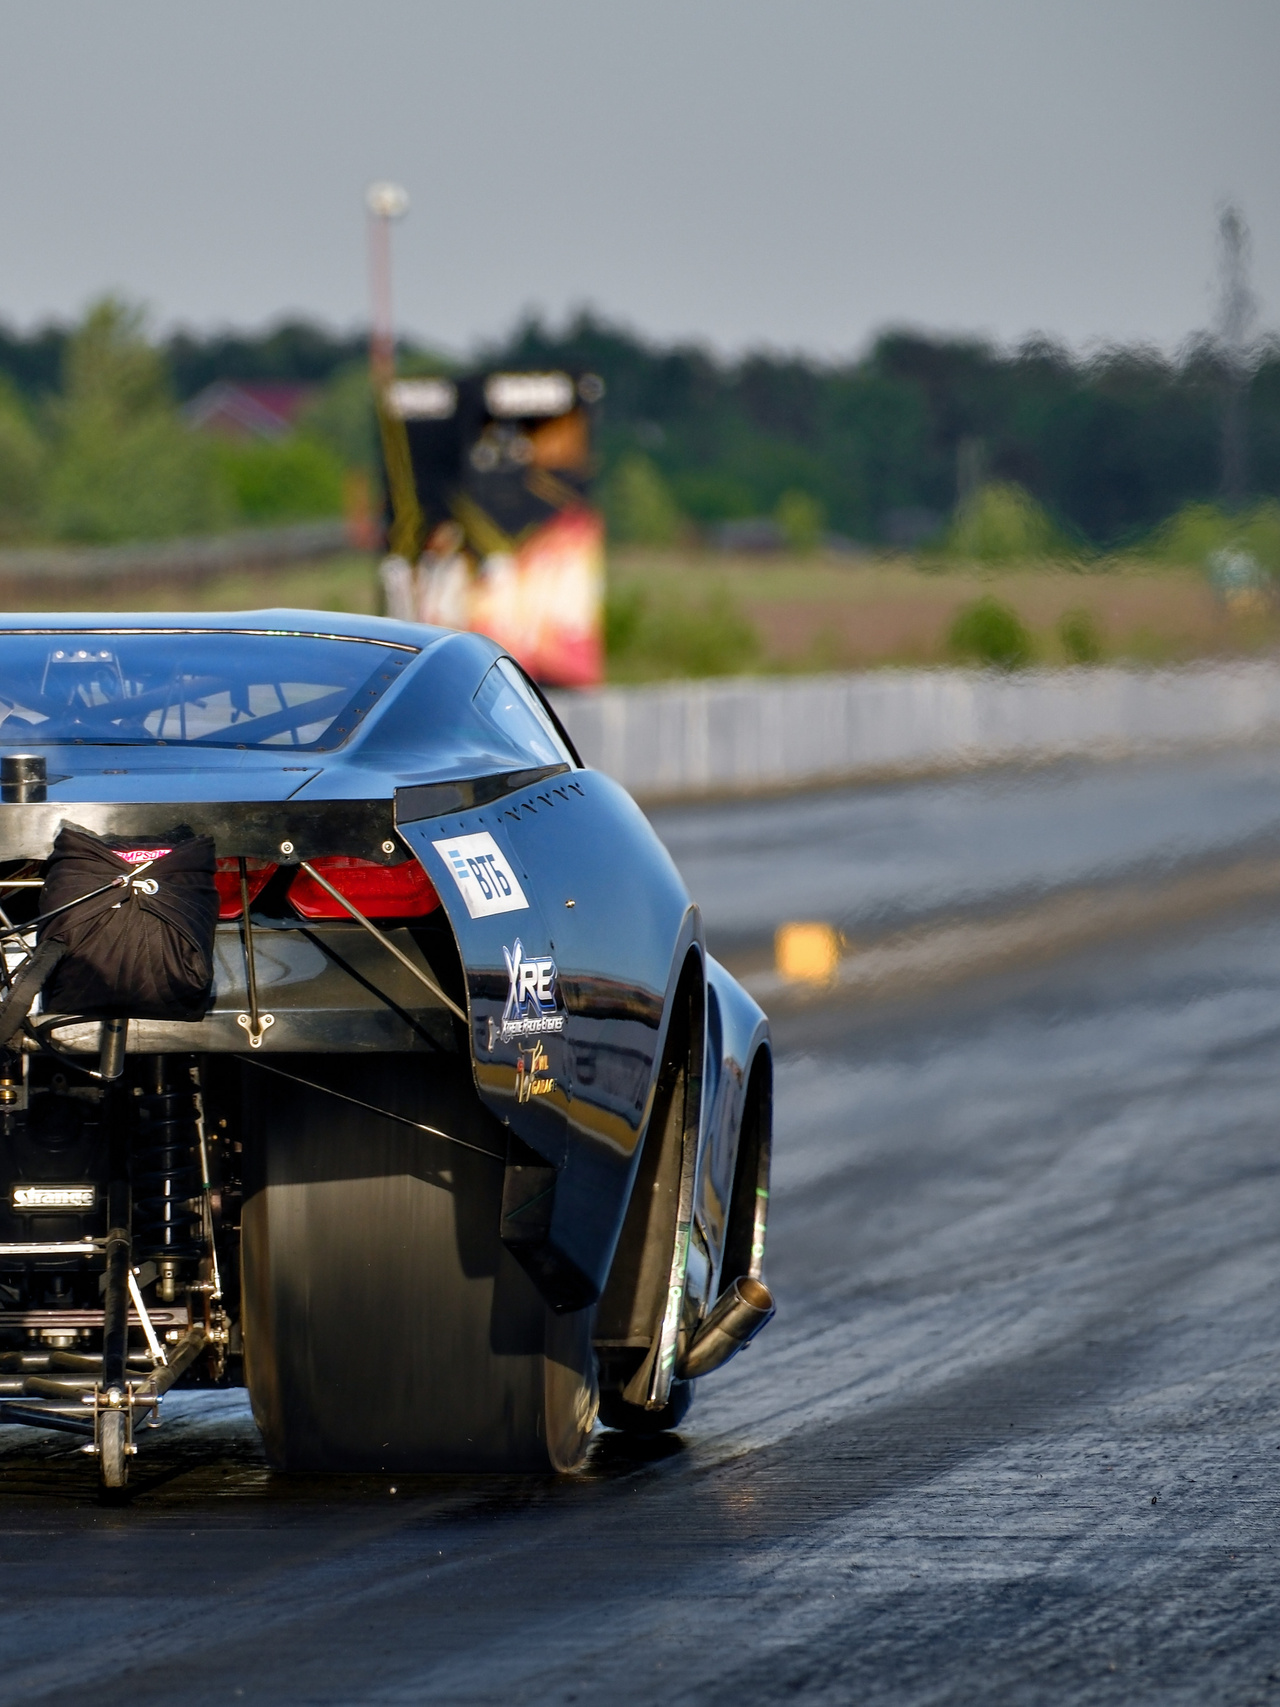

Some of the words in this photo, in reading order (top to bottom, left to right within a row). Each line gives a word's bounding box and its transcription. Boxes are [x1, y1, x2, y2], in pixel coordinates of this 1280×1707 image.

[116, 849, 169, 861] IMPSON
[466, 854, 512, 900] ВТБ
[502, 938, 558, 1019] XRE
[13, 1187, 94, 1207] Strange
